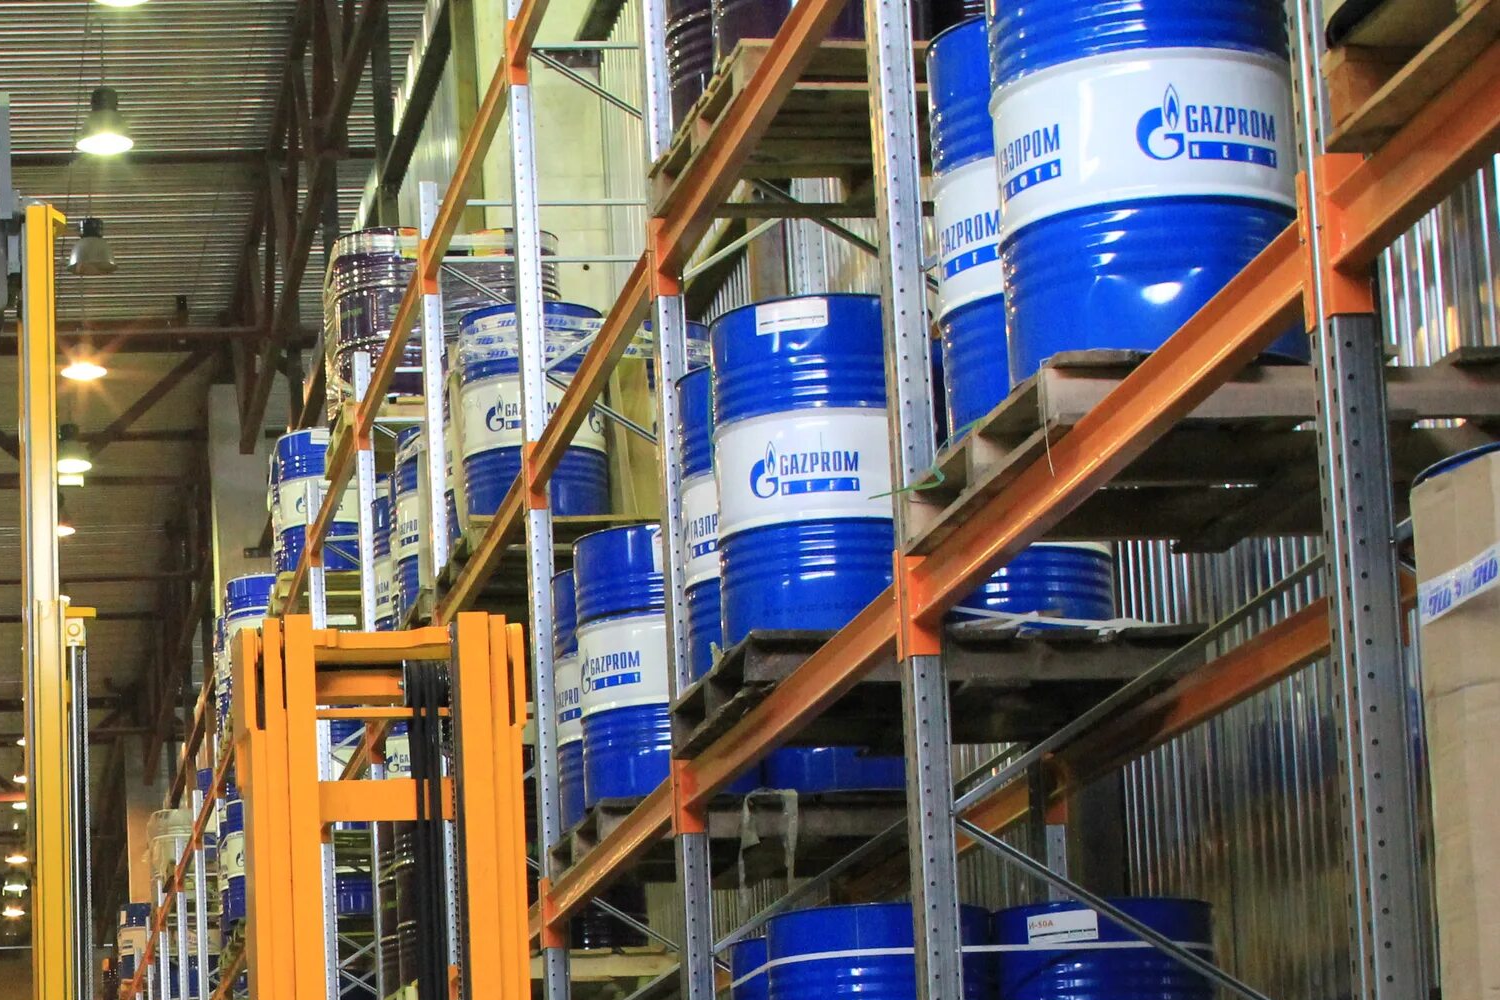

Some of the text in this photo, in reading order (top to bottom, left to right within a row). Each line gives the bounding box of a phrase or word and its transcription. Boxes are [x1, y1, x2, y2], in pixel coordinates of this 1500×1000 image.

[1185, 104, 1276, 143] GAZPROM
[1191, 144, 1275, 167] NEFT
[780, 451, 859, 476] GAZPROM
[783, 479, 858, 495] NEFT
[690, 513, 718, 538] ГАЗПР
[590, 650, 640, 676] GAZPROM
